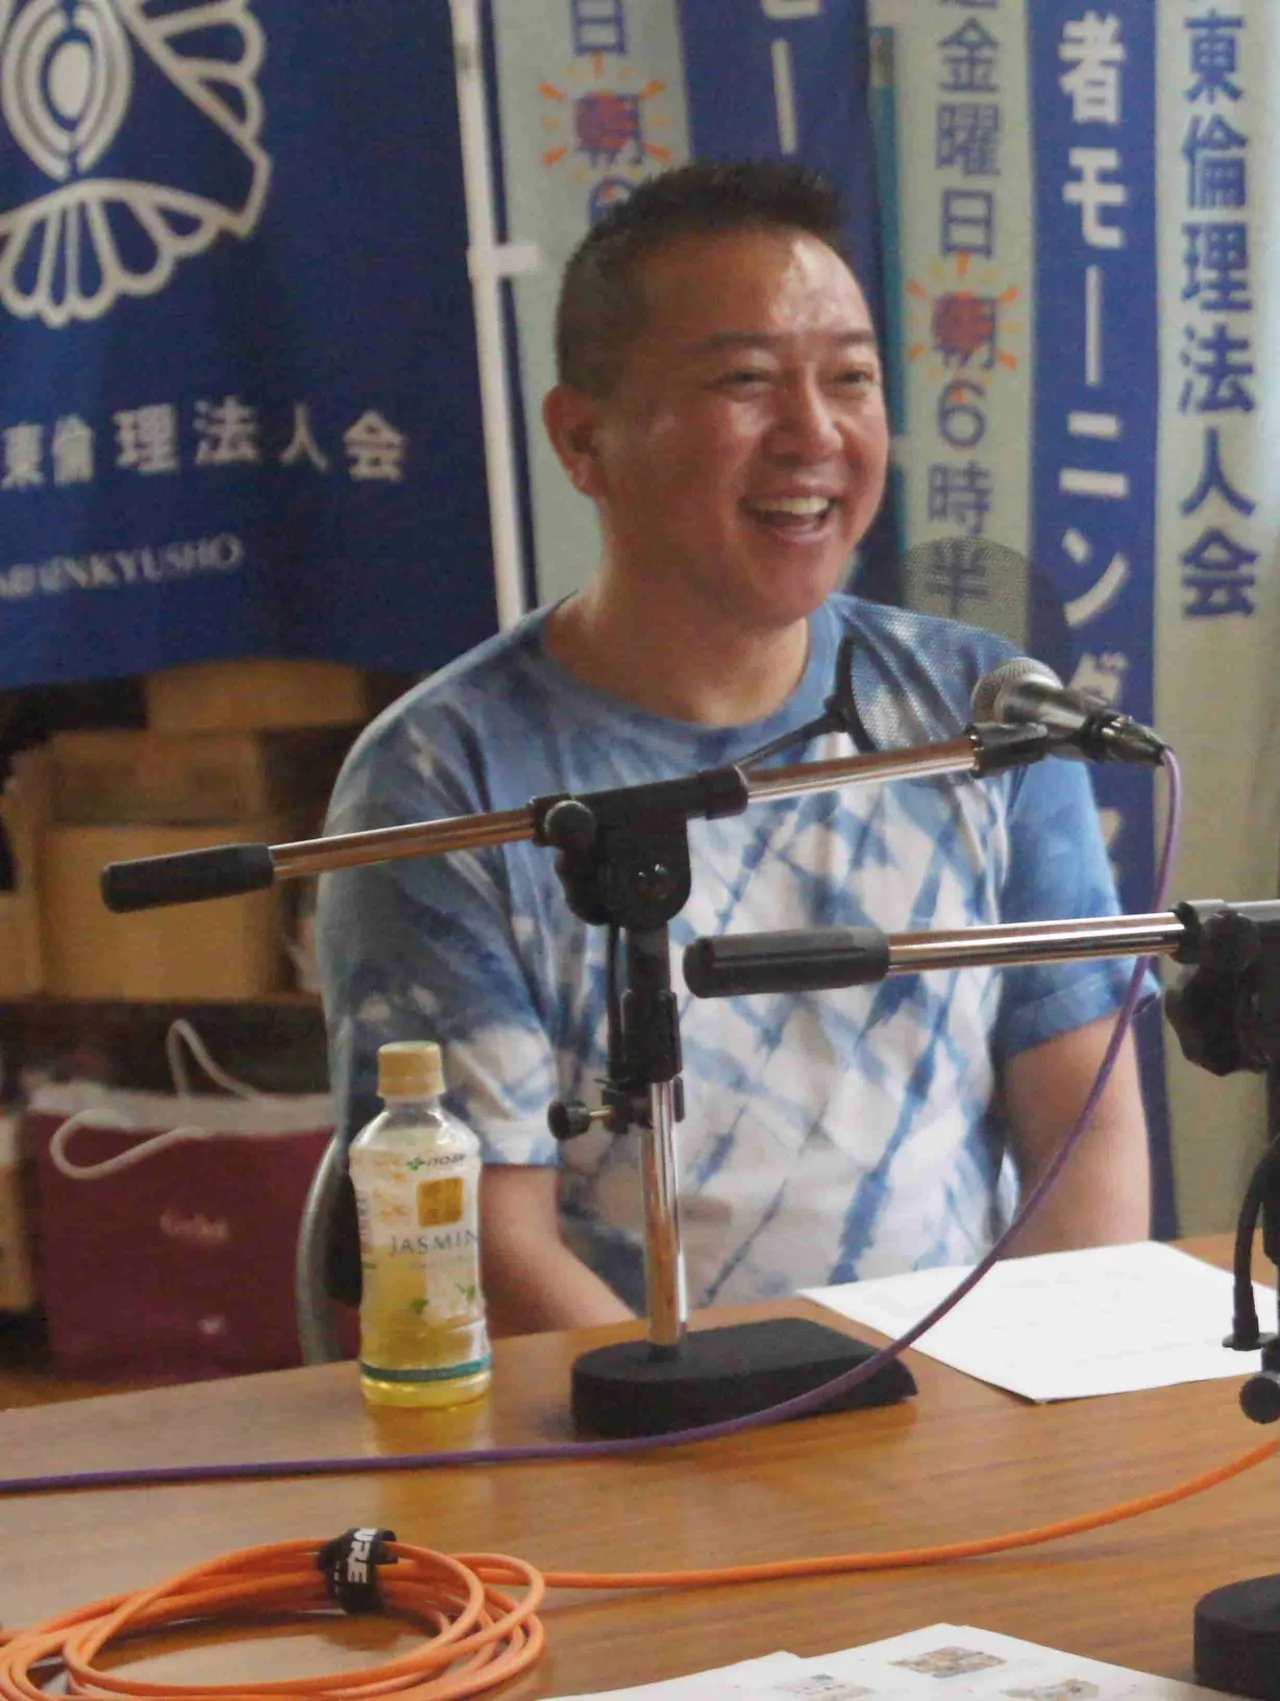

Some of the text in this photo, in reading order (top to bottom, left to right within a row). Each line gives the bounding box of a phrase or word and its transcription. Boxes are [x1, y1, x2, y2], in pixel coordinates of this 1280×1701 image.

[926, 0, 1001, 620] 金曜日朝6時半
[1178, 9, 1259, 618] 東倫理法人会
